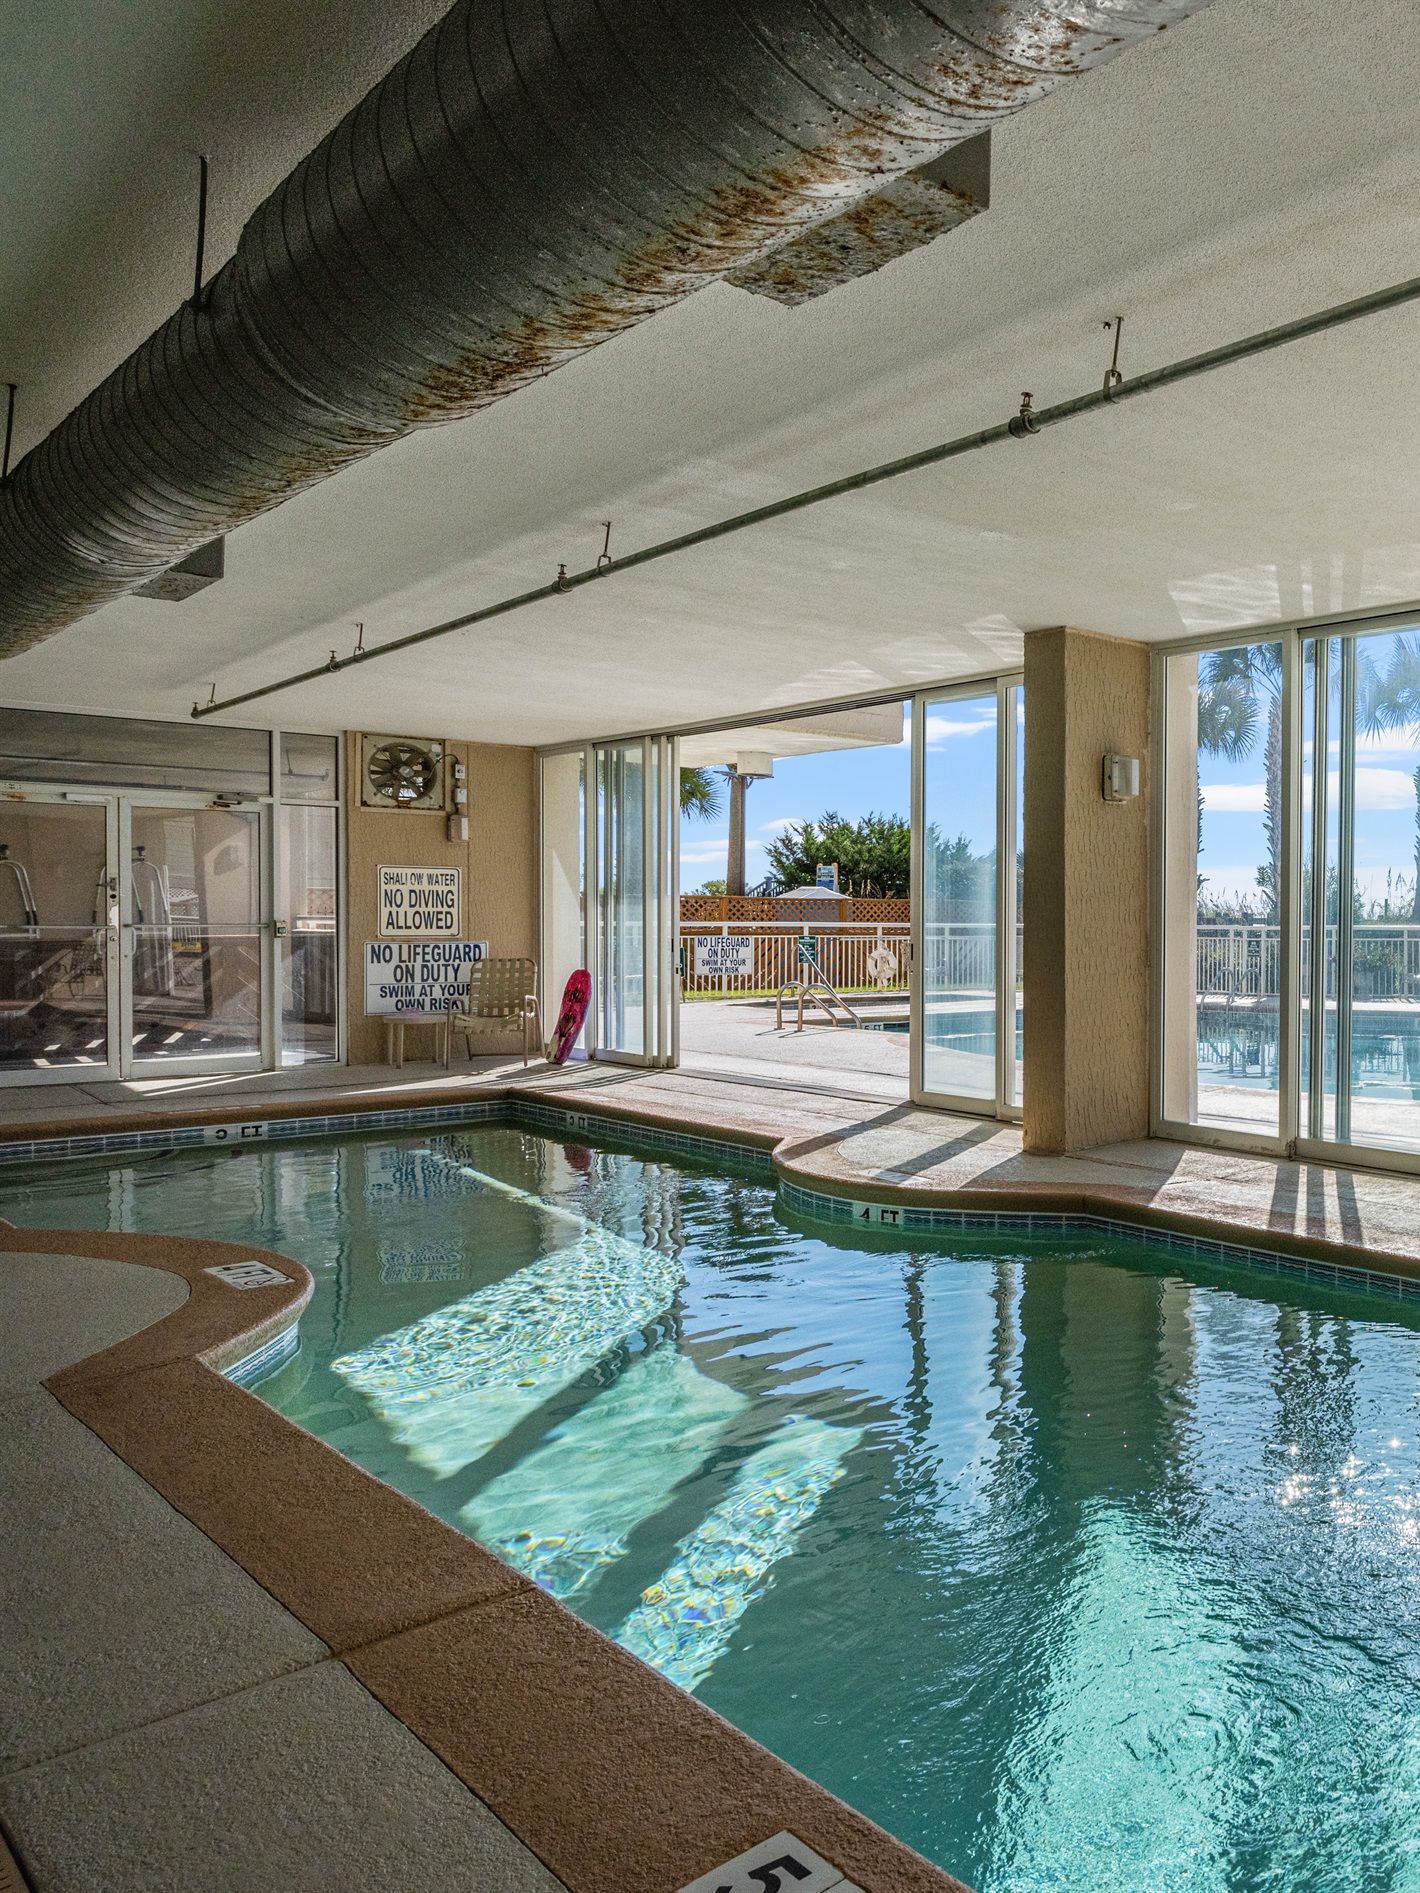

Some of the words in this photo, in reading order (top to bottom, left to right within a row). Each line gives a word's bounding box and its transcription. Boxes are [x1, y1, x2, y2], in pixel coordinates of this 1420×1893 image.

[427, 873, 456, 886] WATER
[384, 889, 404, 908] NO
[409, 889, 455, 909] DIVING
[386, 910, 454, 930] ALLOWED
[697, 937, 708, 948] NO
[710, 937, 750, 948] LIFEGUARD
[370, 945, 393, 964] NO
[398, 943, 482, 964] LIFEGUARD
[707, 948, 718, 958] ON
[720, 948, 740, 958] DUTY
[729, 959, 747, 967] YOUR
[393, 964, 415, 983] ON
[420, 963, 461, 983] DUTY
[724, 966, 739, 974] RISK
[380, 985, 415, 998] SWIM
[419, 985, 435, 997] AT
[395, 999, 425, 1011] OWN
